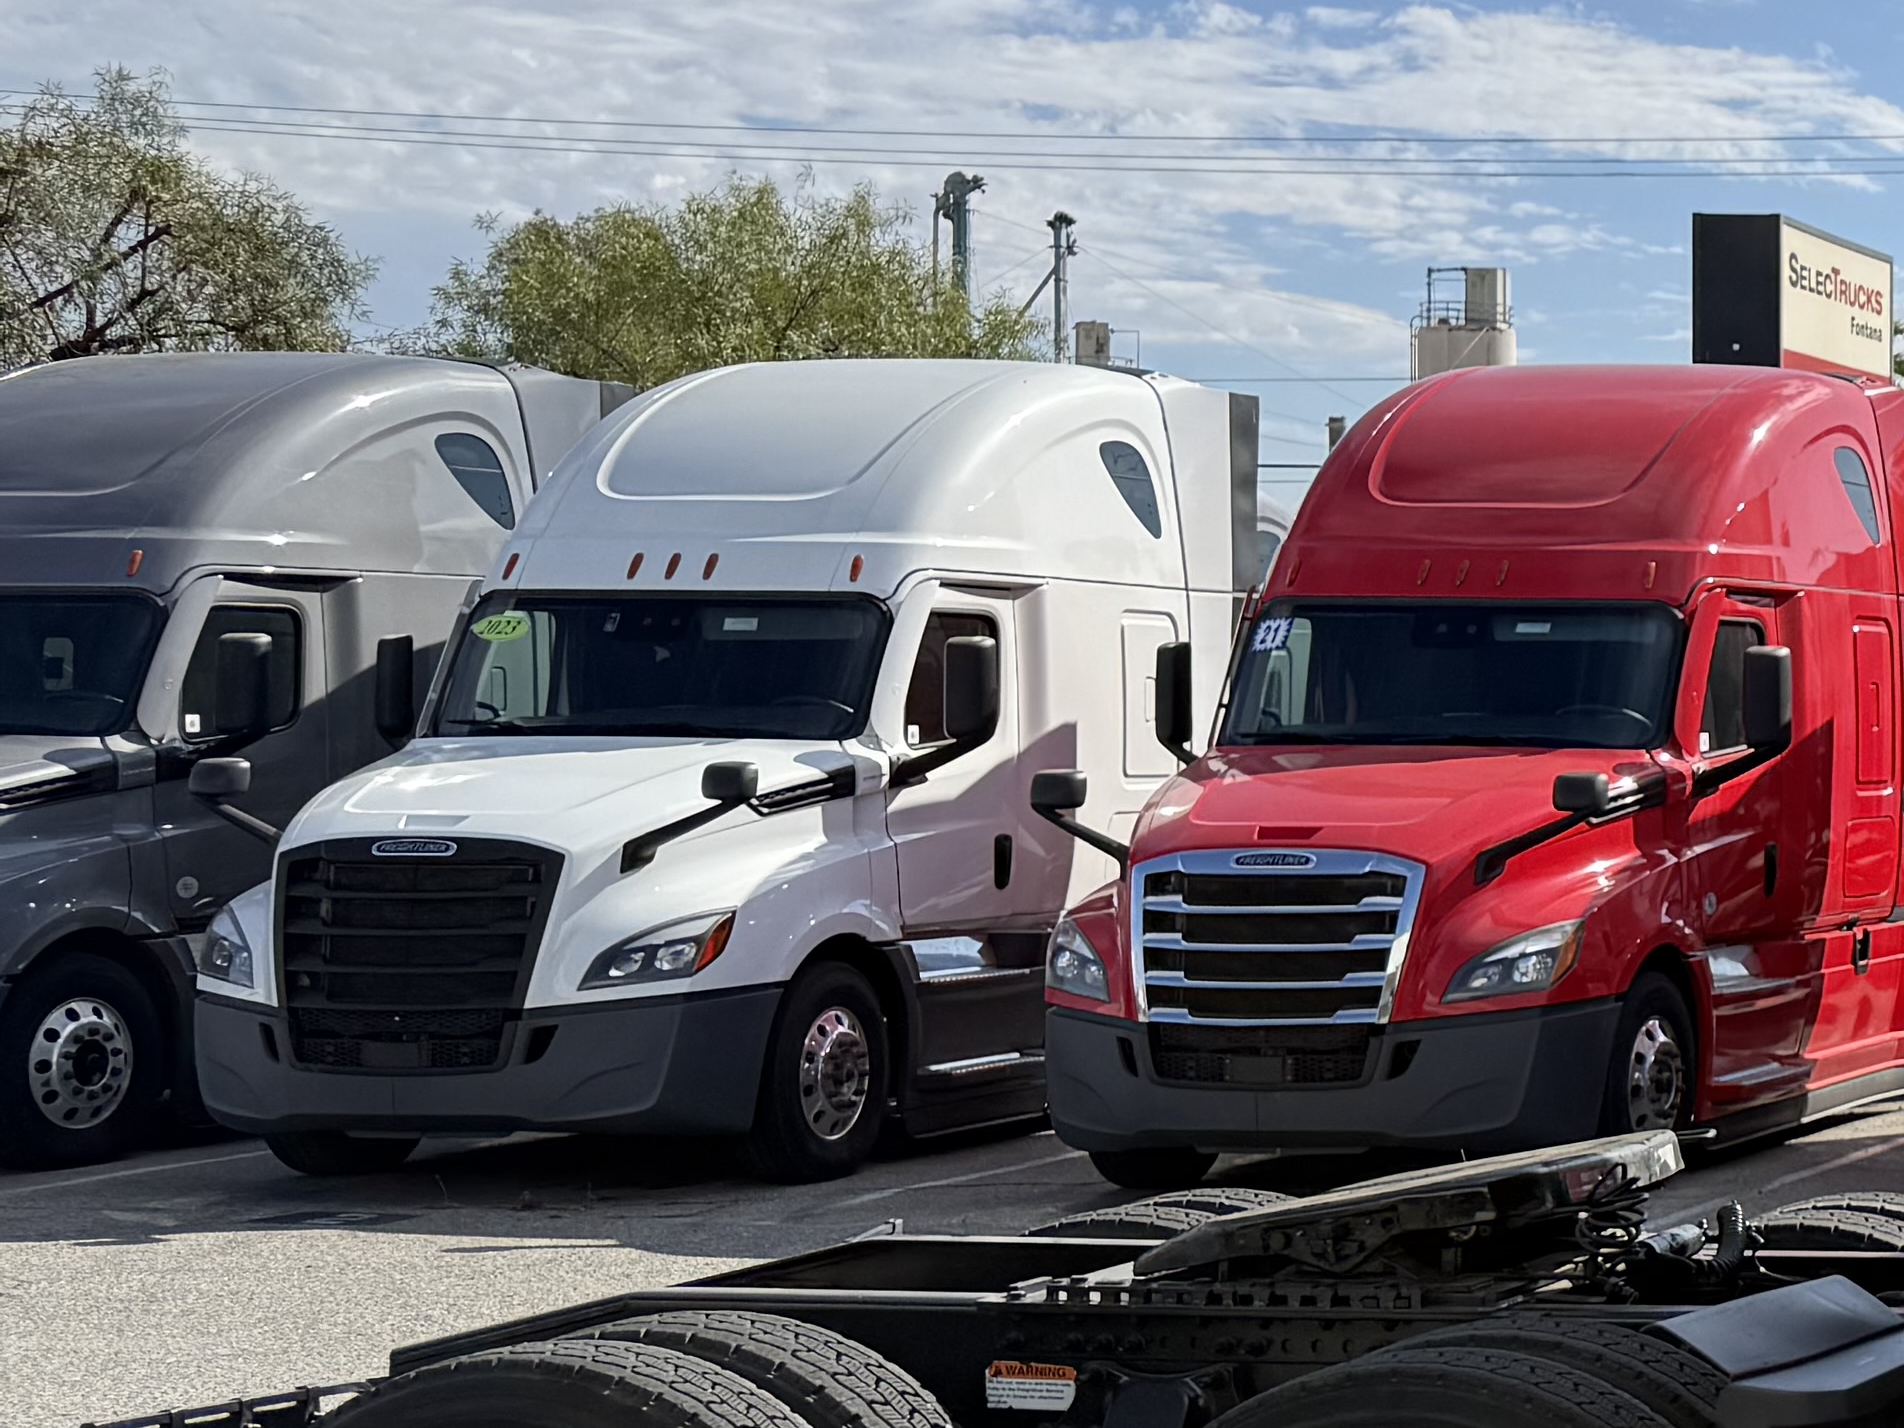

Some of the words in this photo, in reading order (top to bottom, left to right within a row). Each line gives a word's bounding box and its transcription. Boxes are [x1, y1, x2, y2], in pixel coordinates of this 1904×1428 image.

[1788, 252, 1883, 316] SELECTRUCKS
[1850, 316, 1883, 342] Fontana
[1259, 624, 1281, 644] 21
[1005, 1365, 1067, 1378] WARNING
